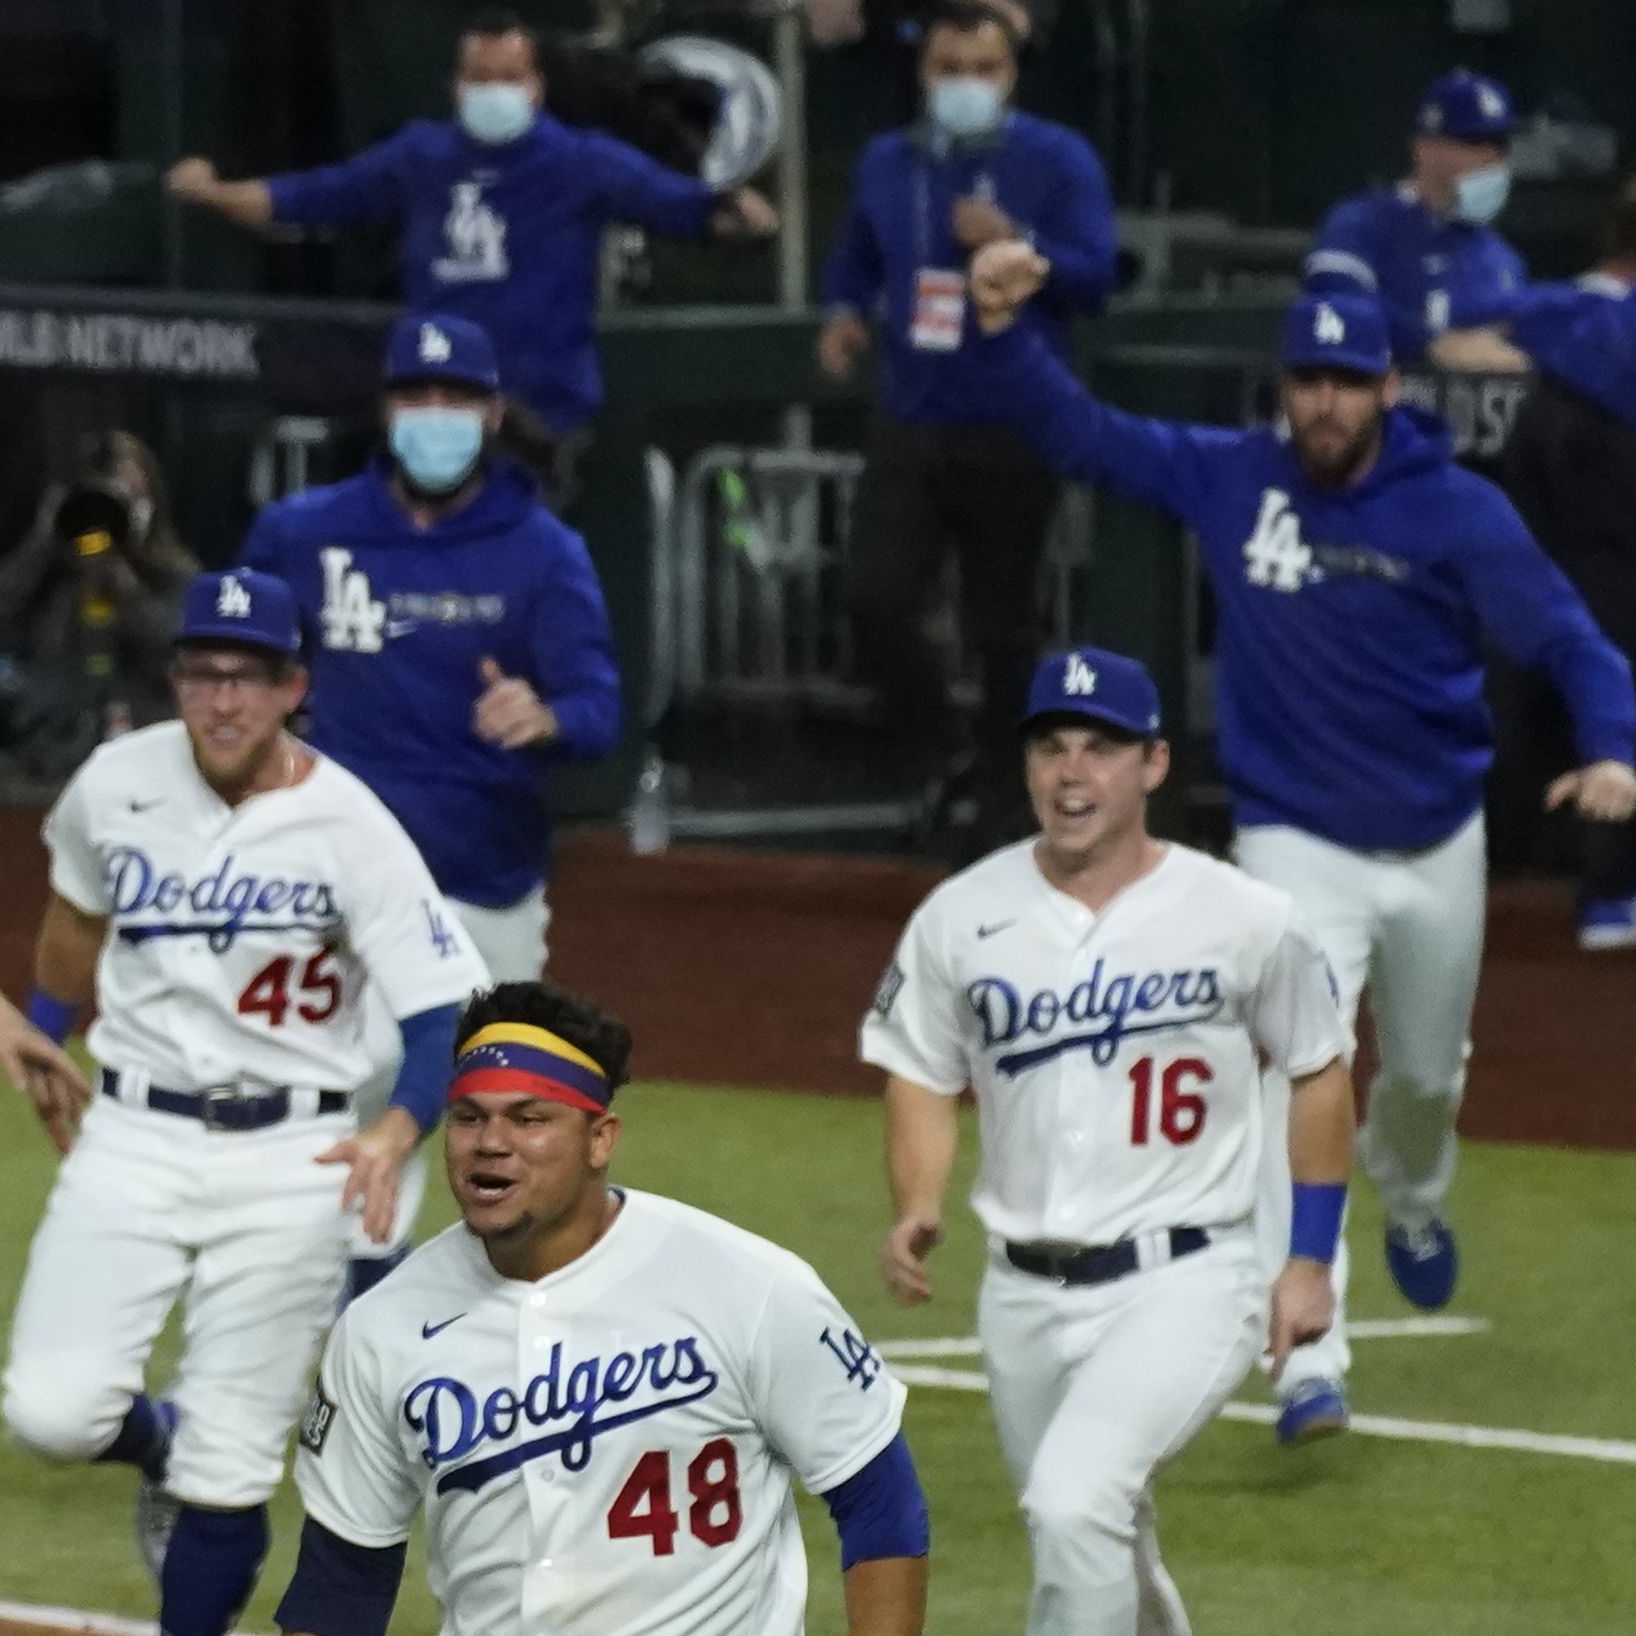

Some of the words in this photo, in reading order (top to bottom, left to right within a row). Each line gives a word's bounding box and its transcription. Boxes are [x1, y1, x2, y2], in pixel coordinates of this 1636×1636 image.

[70, 313, 261, 376] NETWORK
[1242, 487, 1313, 592] LA
[217, 575, 251, 618] LA
[319, 548, 386, 653] LA
[1063, 652, 1097, 697] LA
[107, 847, 342, 955] Dodgers
[238, 947, 342, 1029] 45
[966, 958, 1224, 1068] Dodgers
[1128, 1055, 1214, 1148] 16
[404, 1335, 720, 1473] Dodgers
[819, 1325, 881, 1393] LA
[607, 1437, 745, 1557] 48
